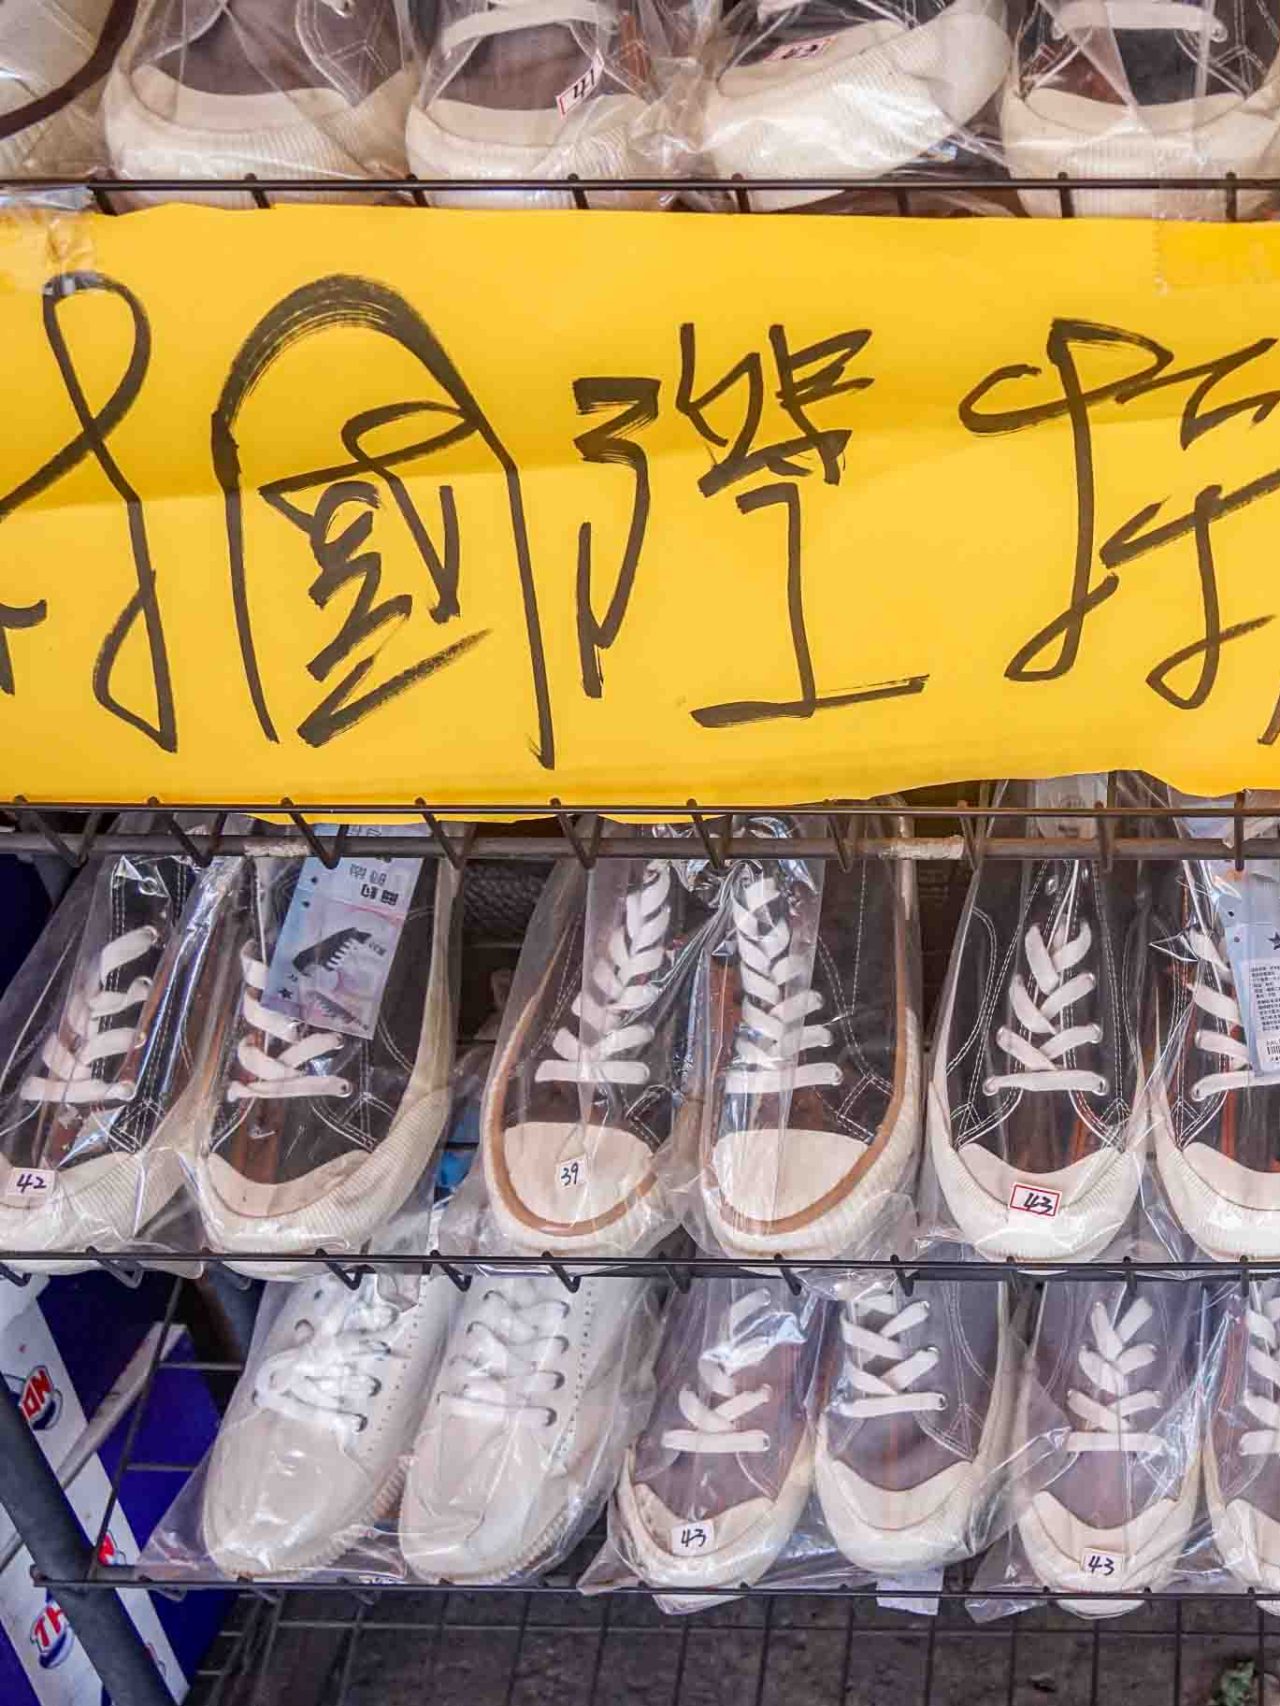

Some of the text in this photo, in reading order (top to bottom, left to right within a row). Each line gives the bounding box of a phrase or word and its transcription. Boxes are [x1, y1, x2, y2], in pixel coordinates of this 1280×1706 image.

[15, 1173, 48, 1193] 42
[561, 1161, 579, 1186] 39
[1023, 1191, 1053, 1215] 43
[681, 1529, 707, 1548] 43
[1087, 1554, 1115, 1577] 43
